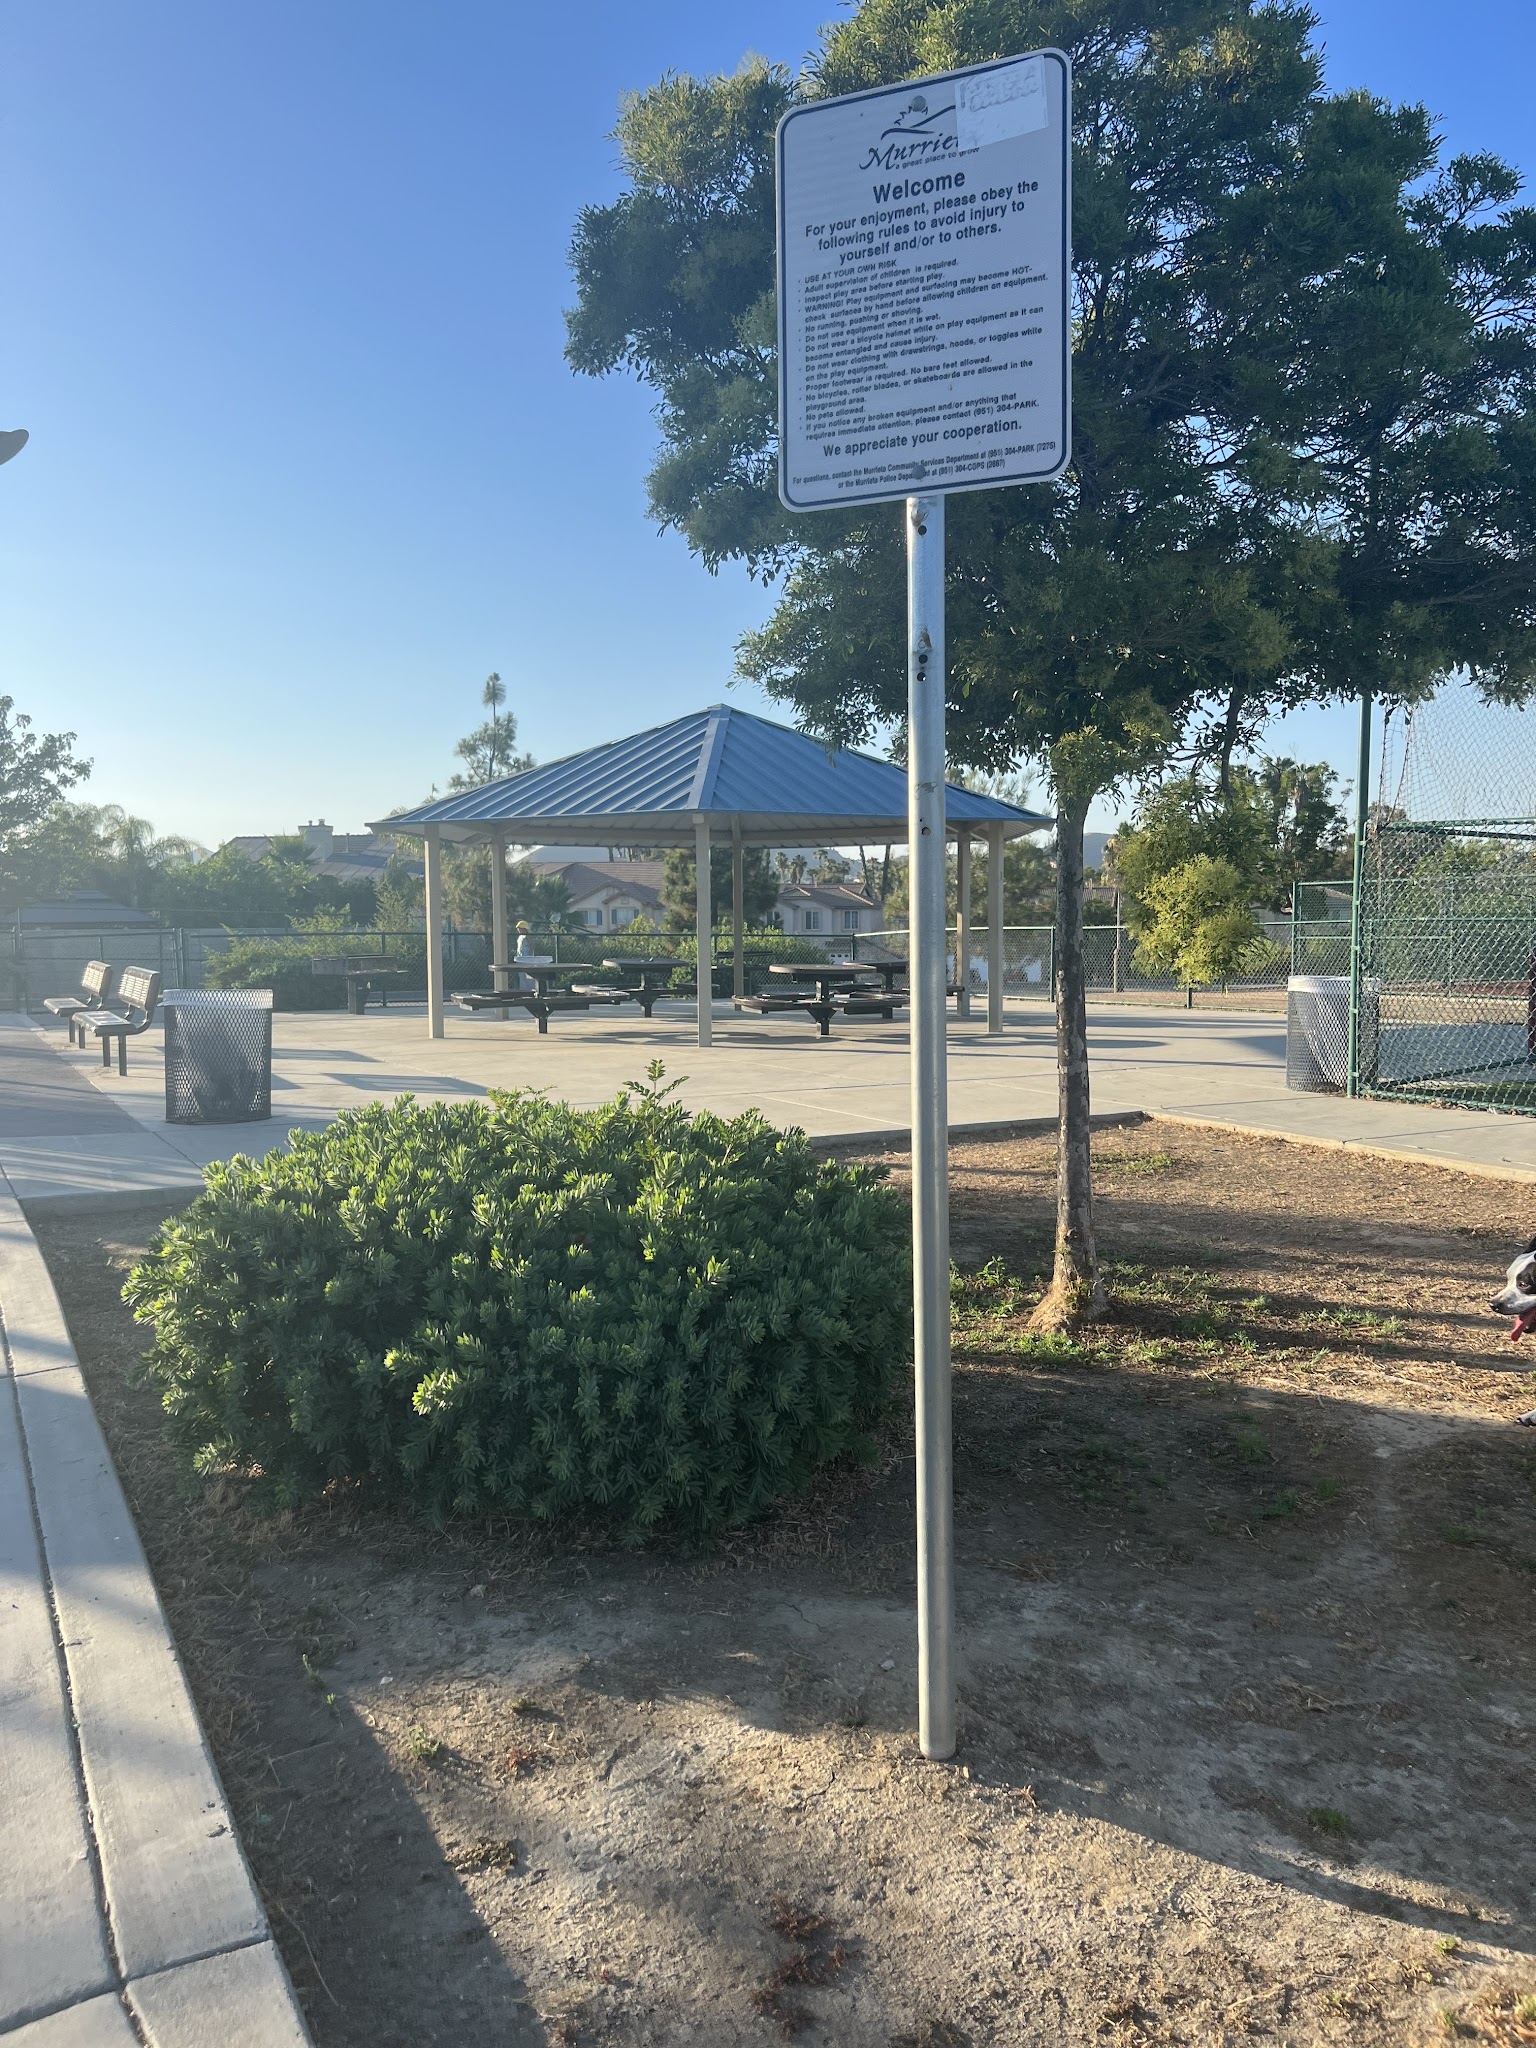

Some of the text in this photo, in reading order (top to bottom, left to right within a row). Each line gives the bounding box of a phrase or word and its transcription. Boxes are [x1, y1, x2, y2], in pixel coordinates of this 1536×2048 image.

[902, 158, 923, 169] great
[925, 154, 946, 165] place
[873, 172, 965, 204] Welcome
[806, 181, 1038, 237] For your enjoyment, please obey the
[818, 200, 1025, 251] following rules to avoid injury to
[839, 223, 1001, 266] yourself and/or to others.
[805, 258, 897, 284] USE AT YOUR OWN RISK
[805, 284, 823, 294] Adult
[826, 276, 868, 289] supervision
[870, 273, 878, 281] of
[880, 268, 910, 279] children
[924, 258, 959, 271] required.
[805, 272, 945, 303] Inspect play area before starting play.
[805, 300, 843, 313] WARNING!
[864, 289, 903, 302] equipment
[905, 285, 919, 295] and
[922, 280, 957, 292] surfacing
[960, 276, 976, 285] may
[978, 271, 1009, 282] become
[805, 273, 1048, 323] check surfaces by hand before allowing children on equipment.
[805, 325, 815, 333] No
[817, 321, 847, 330] running,
[849, 314, 879, 326] pushing
[892, 306, 923, 317] shoving.
[805, 335, 815, 343] Do
[817, 332, 829, 340] not
[846, 322, 884, 336] equipment
[887, 320, 907, 328] when
[925, 313, 941, 322] wet.
[805, 345, 815, 353] Do
[817, 342, 829, 350] not
[831, 340, 848, 348] wear
[857, 333, 883, 343] bicycle
[886, 328, 911, 338] helmet
[913, 324, 933, 334] while
[947, 320, 963, 330] play
[966, 311, 1007, 326] equipment
[1009, 310, 1019, 318] as
[1021, 308, 1027, 316] it
[1029, 306, 1043, 314] can
[805, 335, 938, 362] become entangled and cause injury.
[817, 362, 829, 370] not
[850, 354, 880, 364] clothing
[883, 350, 898, 359] with
[900, 343, 947, 356] drawstrings,
[949, 338, 976, 348] hoods,
[989, 331, 1019, 342] toggles
[1021, 327, 1042, 336] while
[806, 383, 830, 392] Proper
[832, 377, 864, 387] footwear
[875, 369, 909, 381] required.
[911, 367, 921, 375] No
[923, 364, 940, 373] bare
[943, 361, 957, 369] feet
[960, 355, 992, 367] allowed.
[818, 390, 849, 399] bicycles,
[852, 386, 872, 394] roller
[874, 381, 901, 391] blades,
[913, 370, 960, 384] skateboards
[963, 369, 975, 377] are
[978, 362, 1008, 374] allowed
[1010, 361, 1018, 369] in
[1020, 359, 1033, 368] the
[830, 370, 845, 379] play
[848, 362, 888, 375] equipment.
[806, 398, 846, 413] playground
[806, 392, 1016, 431] If you notice any broken equipment and/or anything that
[806, 399, 1039, 441] requires immediate attention, please contact (951) 304-PARK.
[818, 412, 833, 420] pets
[836, 405, 866, 416] allowed.
[823, 420, 1022, 457] We appreciate your cooperation.
